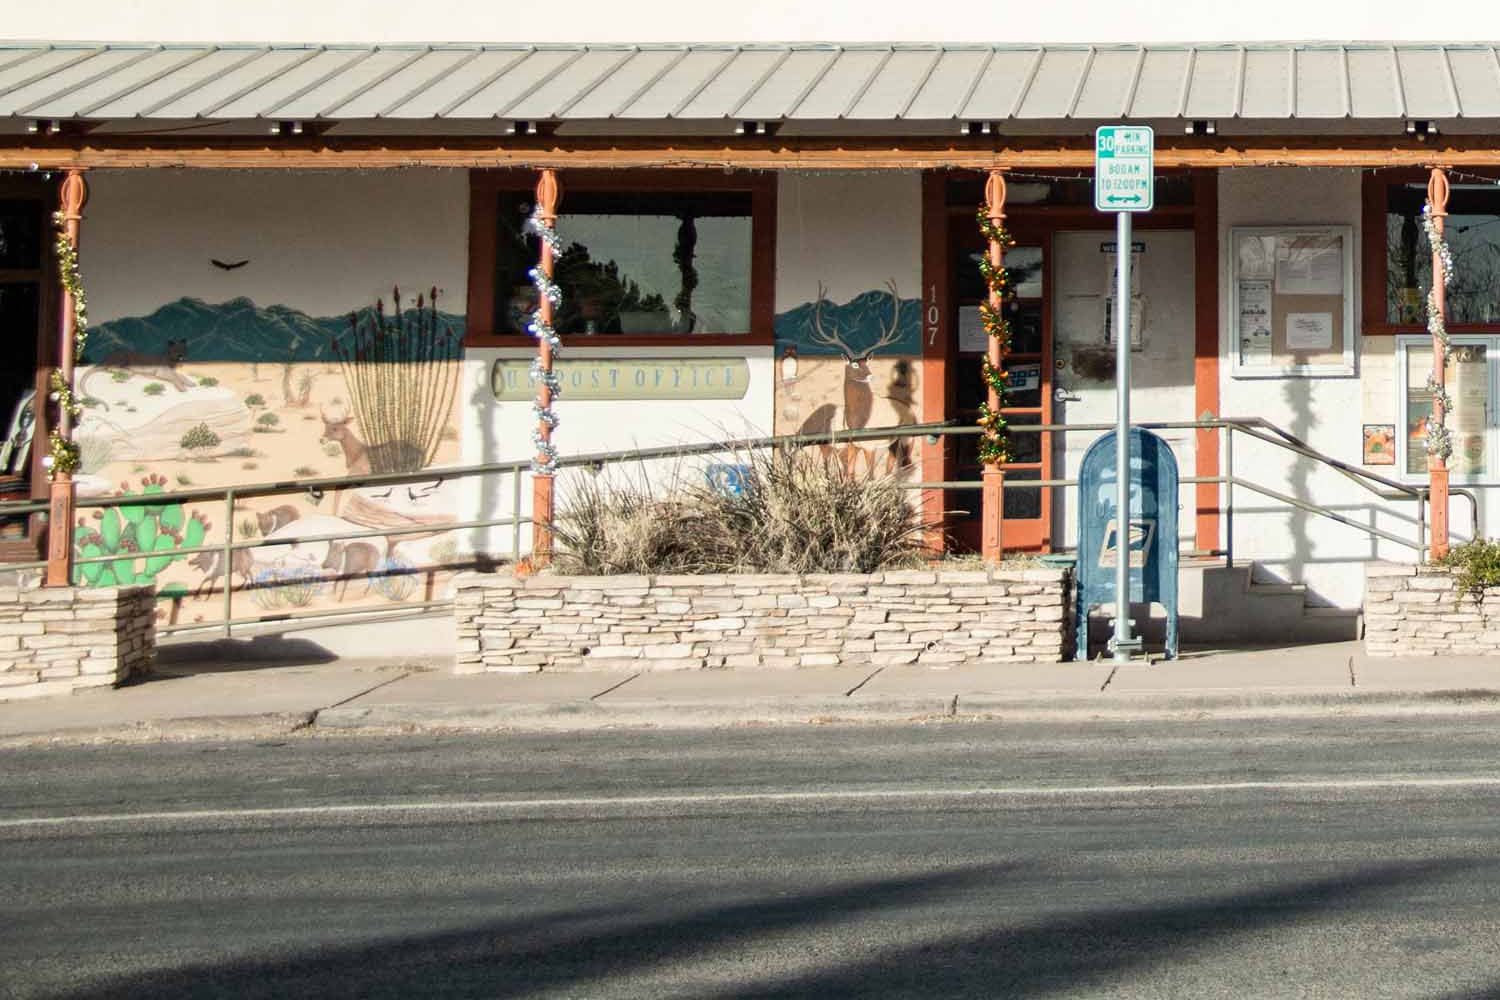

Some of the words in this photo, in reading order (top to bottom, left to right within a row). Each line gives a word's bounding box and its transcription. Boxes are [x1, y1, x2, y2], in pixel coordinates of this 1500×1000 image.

[1098, 135, 1114, 152] 30
[928, 284, 938, 345] 107
[634, 367, 735, 388] OFFICE
